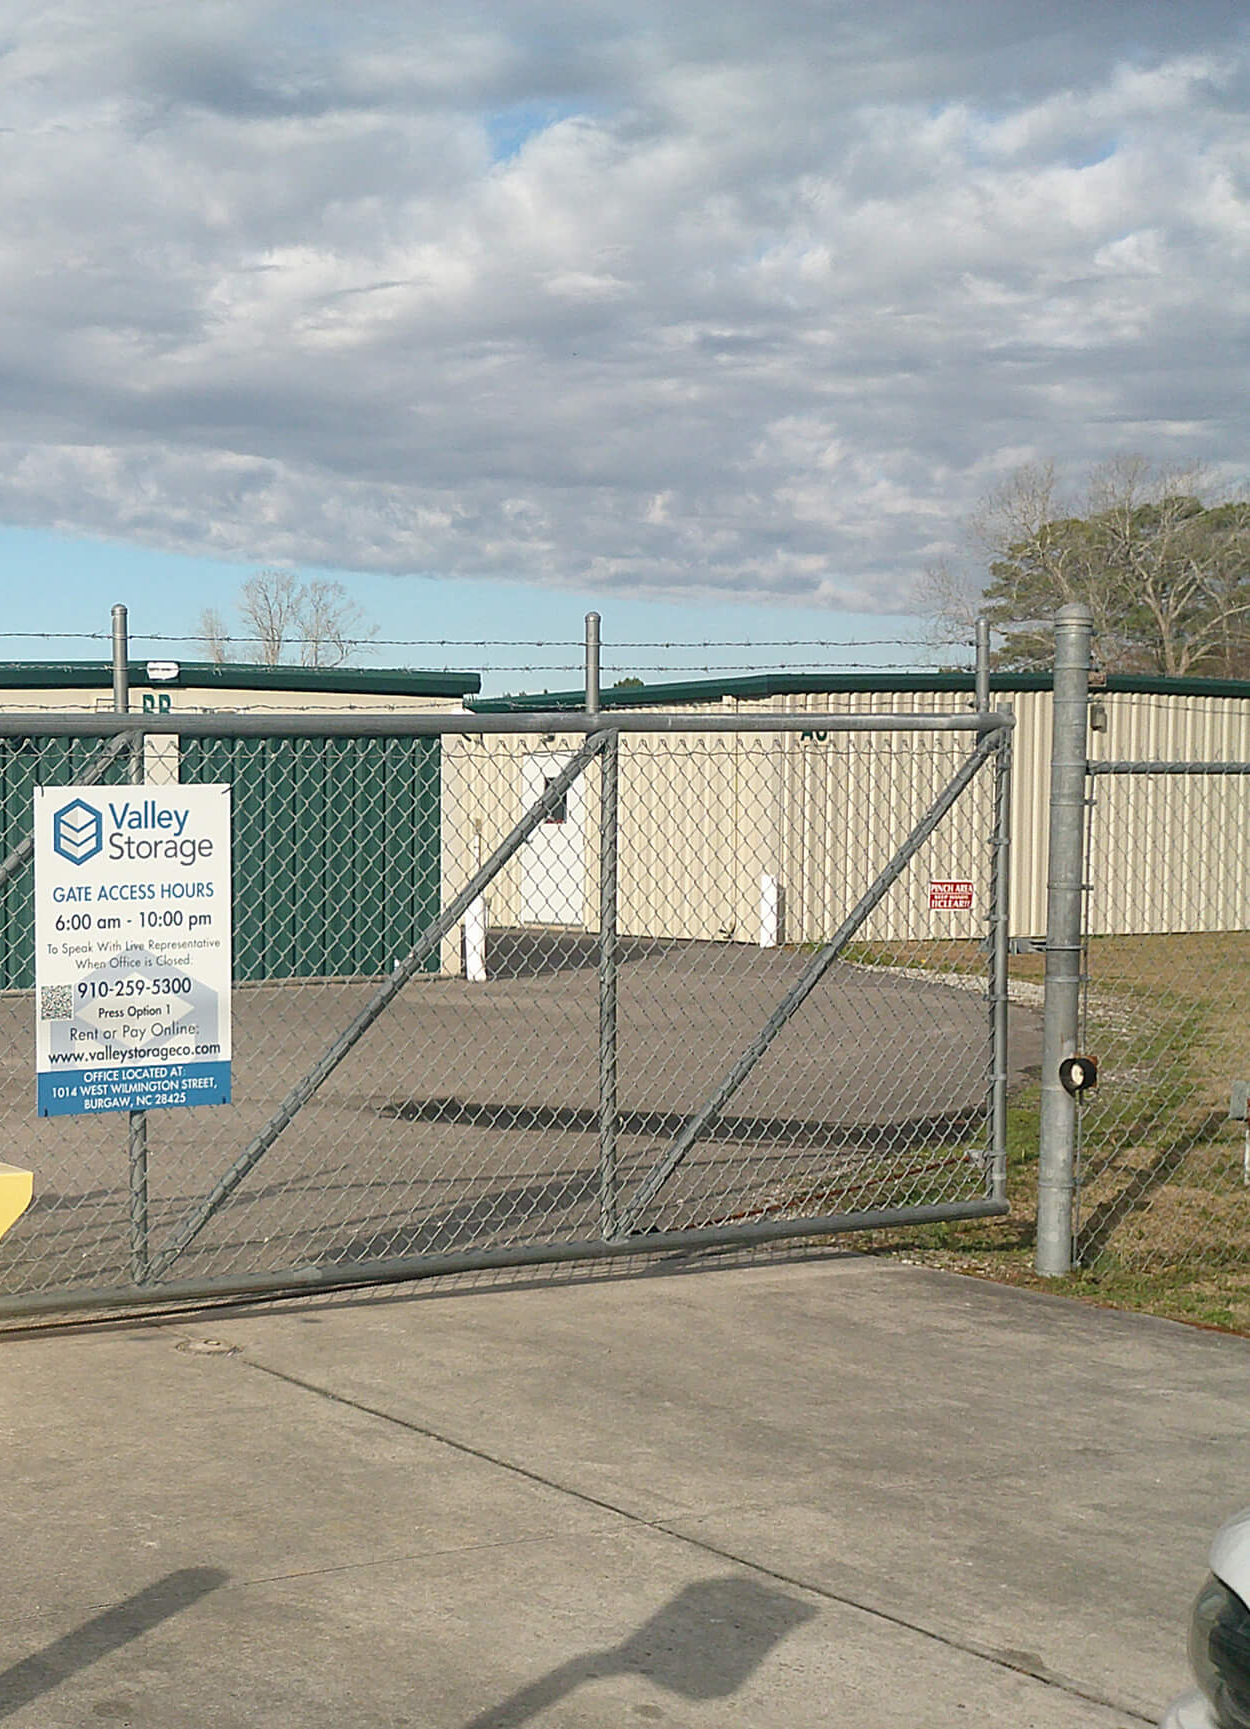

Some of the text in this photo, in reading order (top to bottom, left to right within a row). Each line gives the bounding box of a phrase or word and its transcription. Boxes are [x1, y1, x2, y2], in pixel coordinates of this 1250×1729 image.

[108, 800, 189, 836] Valley
[108, 832, 213, 866] Storage
[53, 882, 214, 903] GATE ACCESS HOURS
[55, 914, 92, 931] 6:00
[97, 917, 121, 929] am
[139, 910, 183, 928] 10:00
[189, 914, 212, 931] pm
[47, 939, 221, 957] To Speak With Live Representative
[75, 958, 107, 970] When
[109, 956, 141, 969] Office
[144, 956, 153, 967] is
[77, 977, 192, 999] 910-259-5300
[98, 1004, 170, 1020] Press Option 1
[70, 1020, 199, 1042] Rent or Pay Online:
[47, 1044, 221, 1064] www.valleystorageco.com
[83, 1070, 119, 1083] OFFICE
[121, 1067, 168, 1080] LOCATED
[52, 1077, 218, 1098] 1014 WEST WILMINGTON STREET,
[84, 1092, 187, 1110] BURGAW, NC 28425
